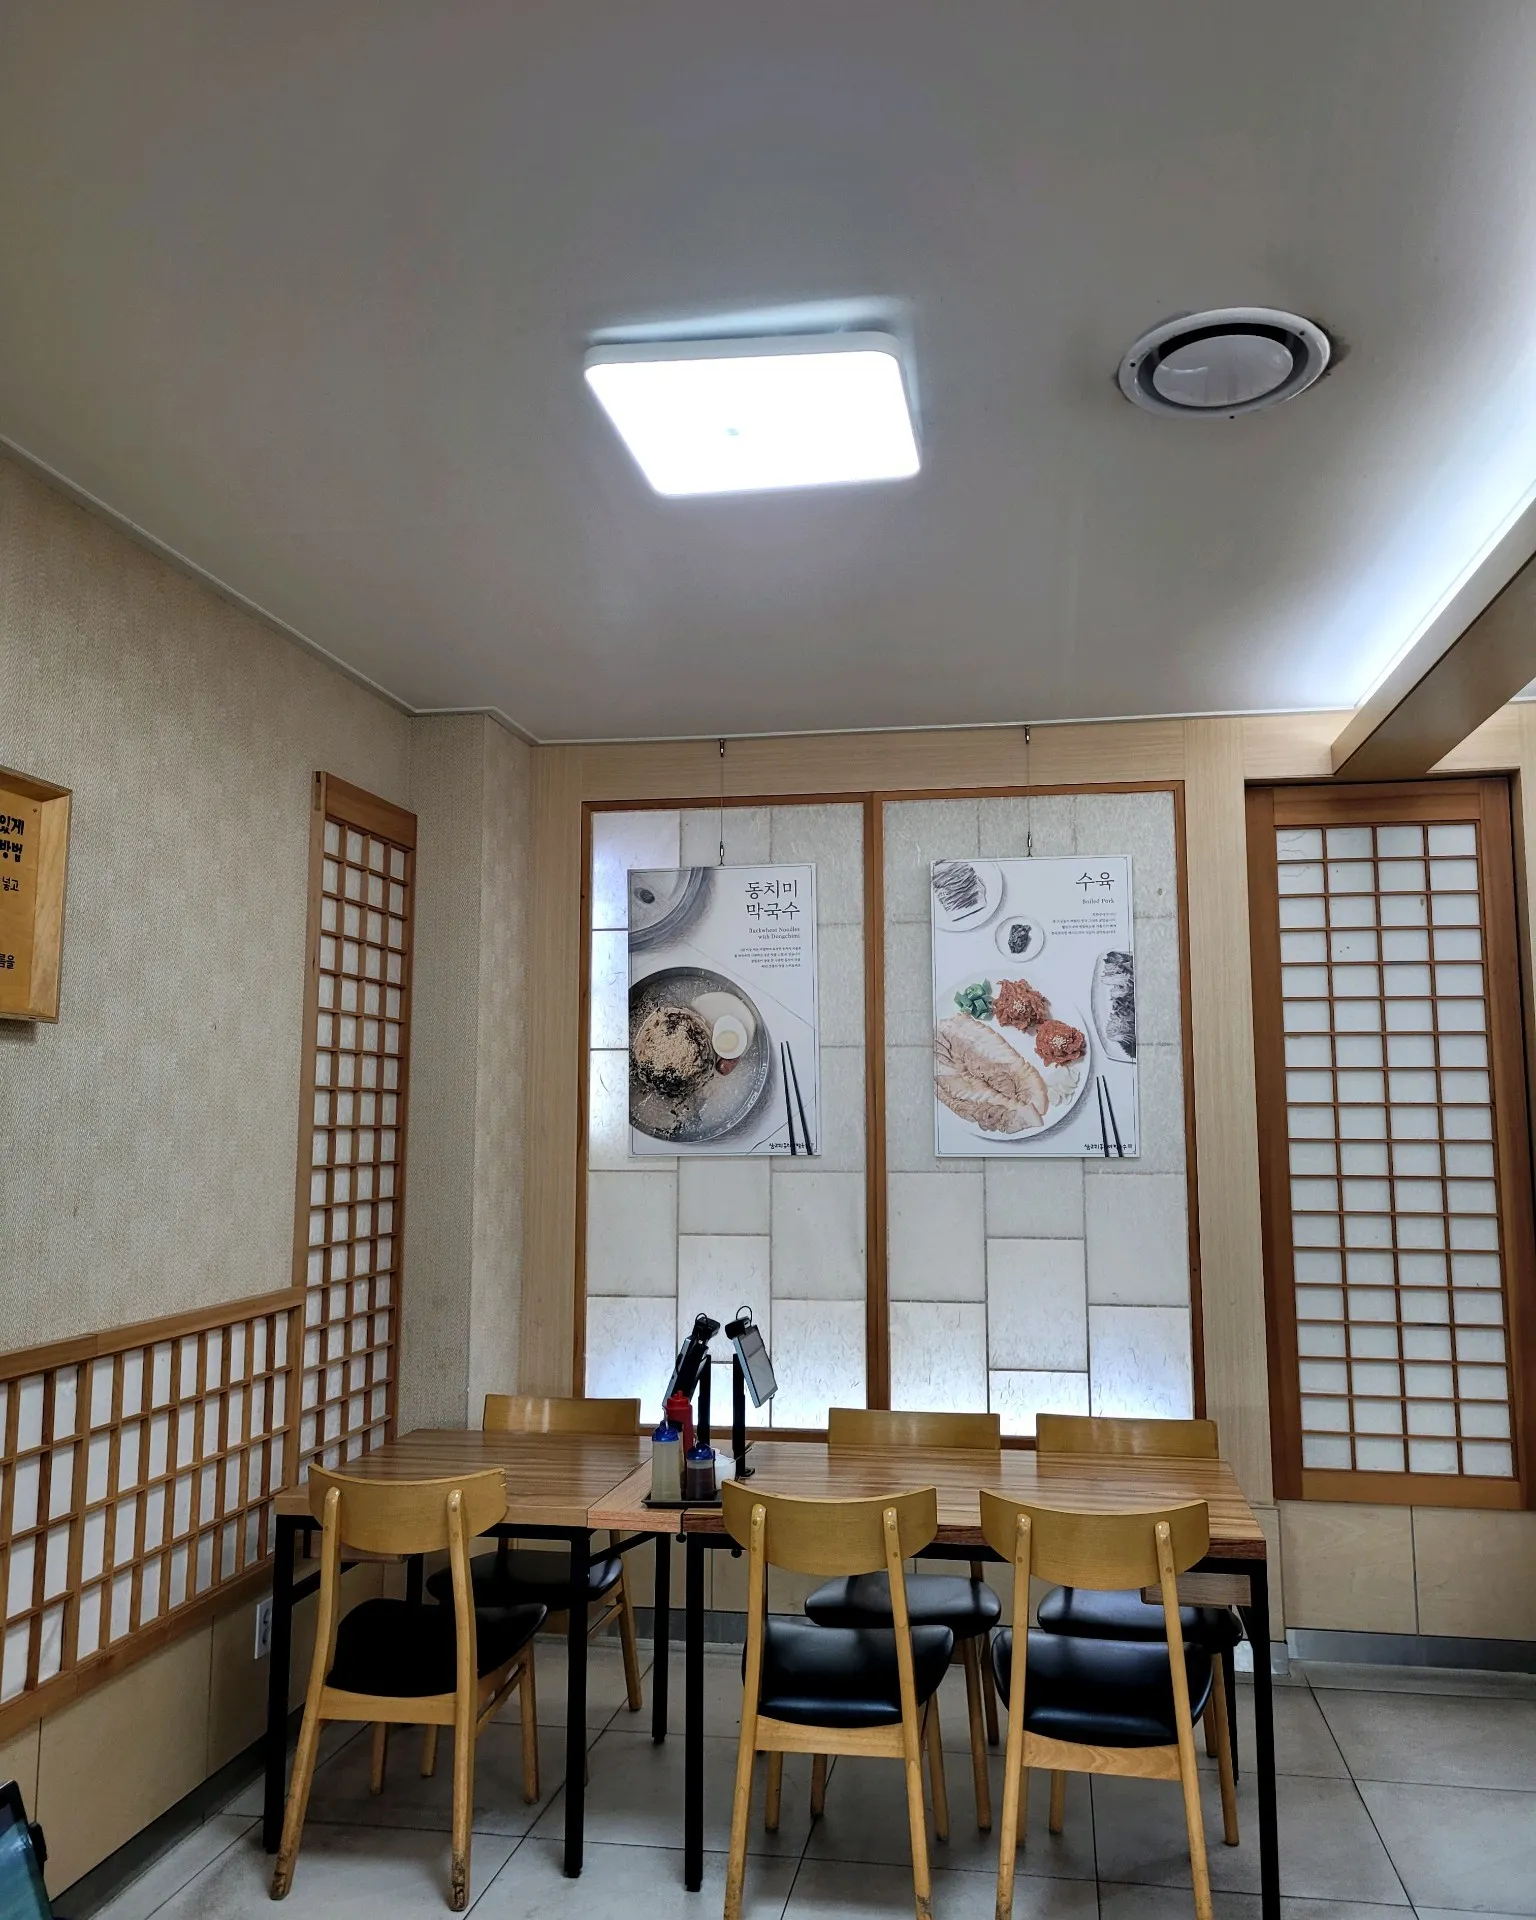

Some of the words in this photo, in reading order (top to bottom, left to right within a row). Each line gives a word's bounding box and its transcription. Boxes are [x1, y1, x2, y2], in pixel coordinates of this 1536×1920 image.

[2, 876, 20, 892] 넣고
[745, 879, 797, 900] 동치미
[1075, 871, 1115, 892] 수육
[746, 901, 800, 921] 막국수
